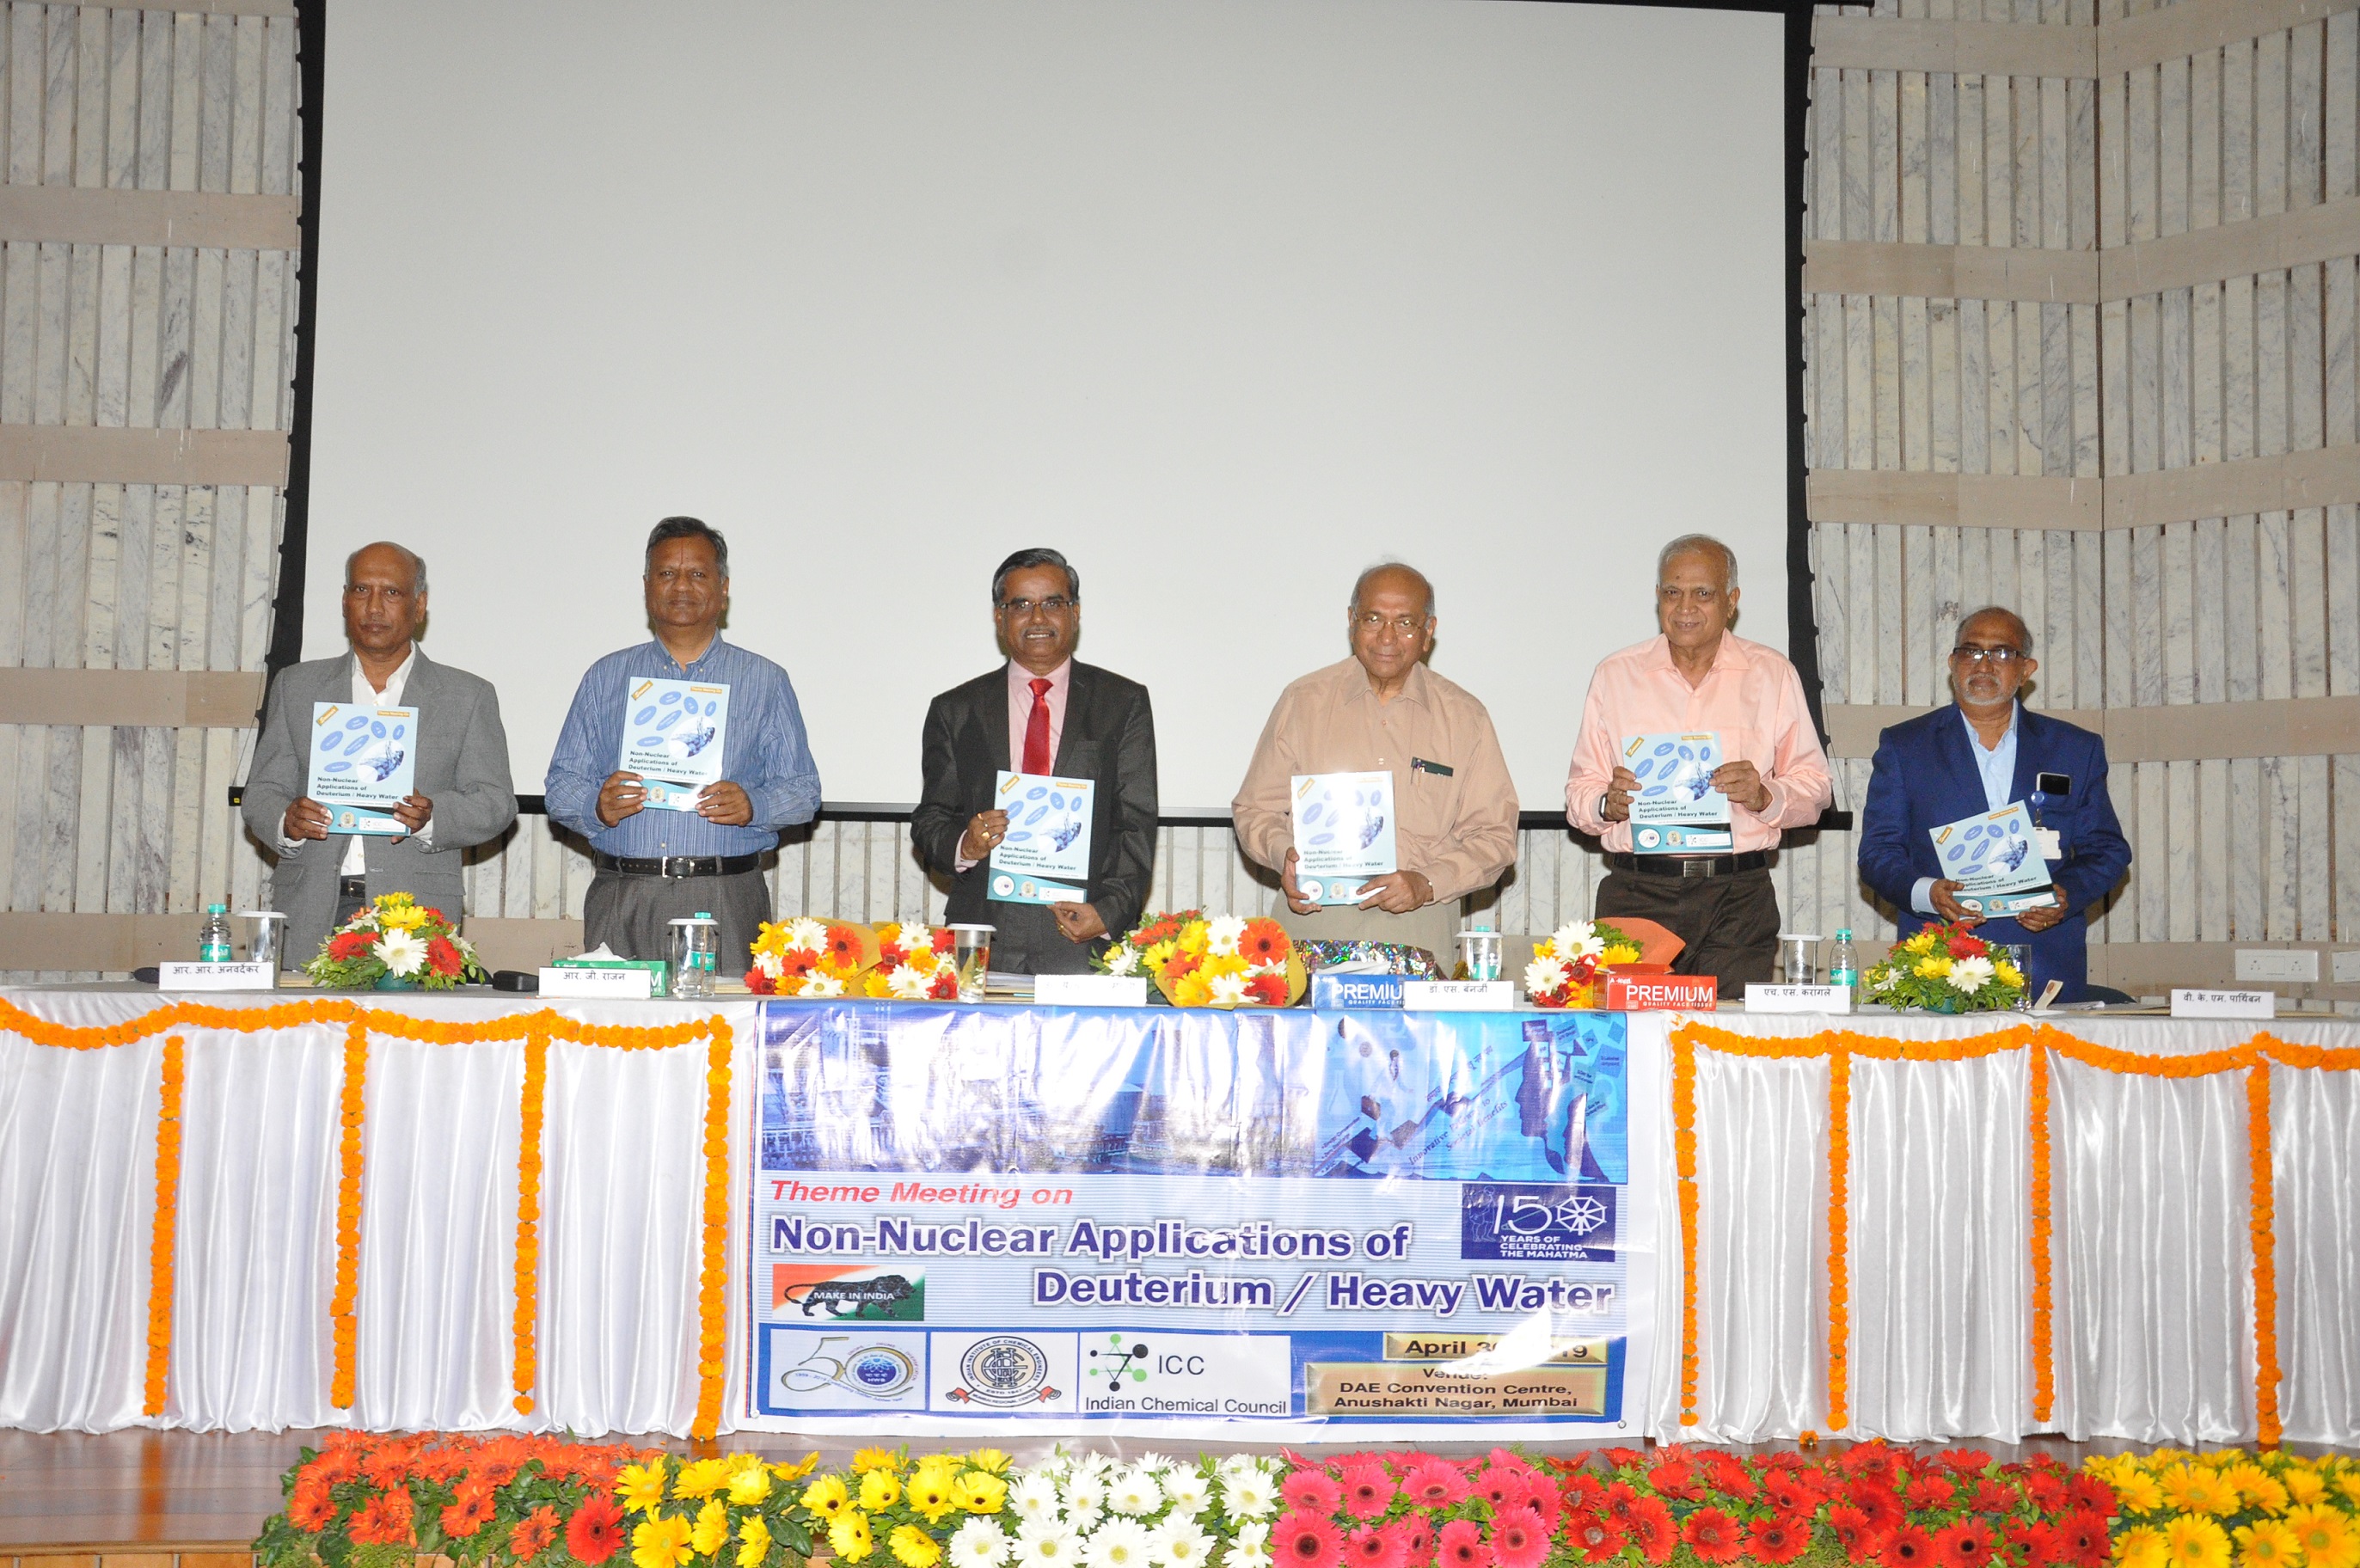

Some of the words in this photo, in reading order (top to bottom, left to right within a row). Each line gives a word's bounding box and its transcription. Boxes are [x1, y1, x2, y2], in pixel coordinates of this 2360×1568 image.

[1000, 845, 1039, 854] Non-Nuclear
[1000, 852, 1039, 861] Applications
[1331, 983, 1403, 1000] PREMIU
[1626, 984, 1713, 1002] PREMIUM
[770, 1179, 880, 1203] Theme
[890, 1182, 1021, 1210] Meeting
[1032, 1188, 1074, 1205] on
[772, 1217, 1057, 1254] Non-Nuclear
[1066, 1219, 1353, 1261] Applications
[1364, 1224, 1410, 1259] of
[1499, 1243, 1583, 1252] CELEBRATING
[1035, 1269, 1273, 1307] Deuterium
[1281, 1273, 1316, 1314] /
[1328, 1274, 1464, 1316] Heavy
[1474, 1276, 1614, 1313] Water
[1405, 1340, 1466, 1357] April
[968, 1343, 990, 1363] INSTITUTE
[1003, 1339, 1033, 1353] CHEMICAL
[1033, 1353, 1043, 1381] ENGINEERS
[1159, 1355, 1205, 1375] ICC
[1339, 1382, 1381, 1393] DAE
[1386, 1382, 1497, 1395] Convention
[1503, 1384, 1572, 1396] Centre,
[1085, 1397, 1135, 1411] Indian
[1141, 1397, 1218, 1412] Chemical
[1224, 1399, 1286, 1414] Council
[1334, 1396, 1428, 1408] Anushakti
[1435, 1398, 1496, 1411] Nagar,
[1503, 1397, 1578, 1408] Mumbai
